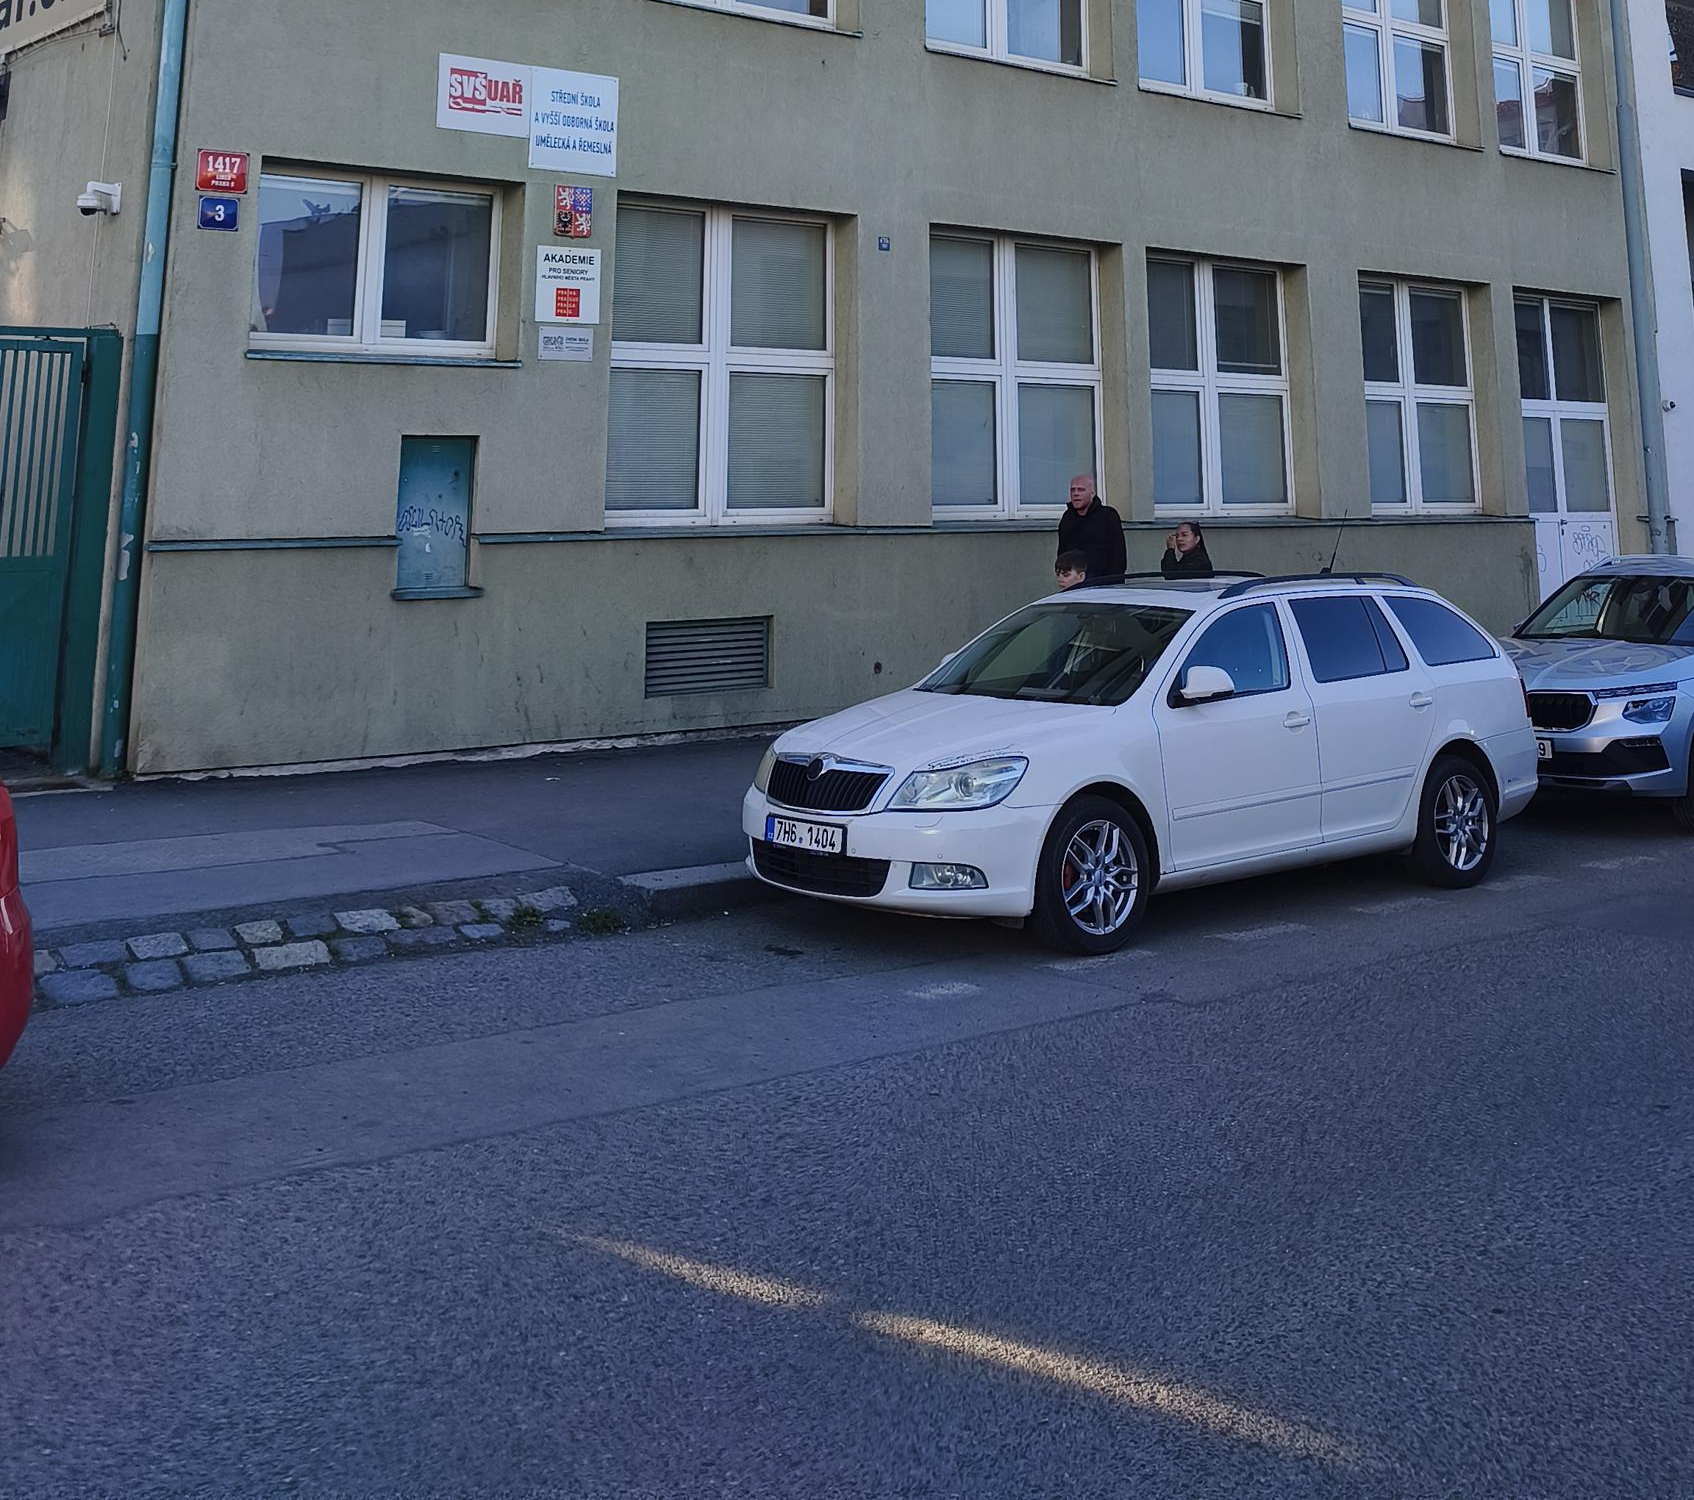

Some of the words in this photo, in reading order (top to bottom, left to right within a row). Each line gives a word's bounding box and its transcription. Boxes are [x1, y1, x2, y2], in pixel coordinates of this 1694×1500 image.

[450, 73, 523, 104] SVŠUAŘ
[551, 89, 579, 104] STŘEDNÍ
[580, 92, 601, 108] ŠKOLA
[535, 114, 540, 123] A
[541, 111, 561, 126] VYŠŠÍ
[562, 115, 593, 130] ODBORNÁ
[594, 120, 615, 133] ŠKOLA
[572, 139, 577, 151] A
[578, 137, 612, 155] ŘEMESLNÁ
[207, 155, 241, 174] 1417
[214, 204, 225, 222] 3
[543, 253, 595, 266] AKADEMIE
[548, 267, 561, 275] PRO
[563, 268, 589, 276] SENIORY
[1538, 741, 1546, 756] 9
[776, 820, 797, 843] 7H6
[807, 826, 836, 850] 1404
